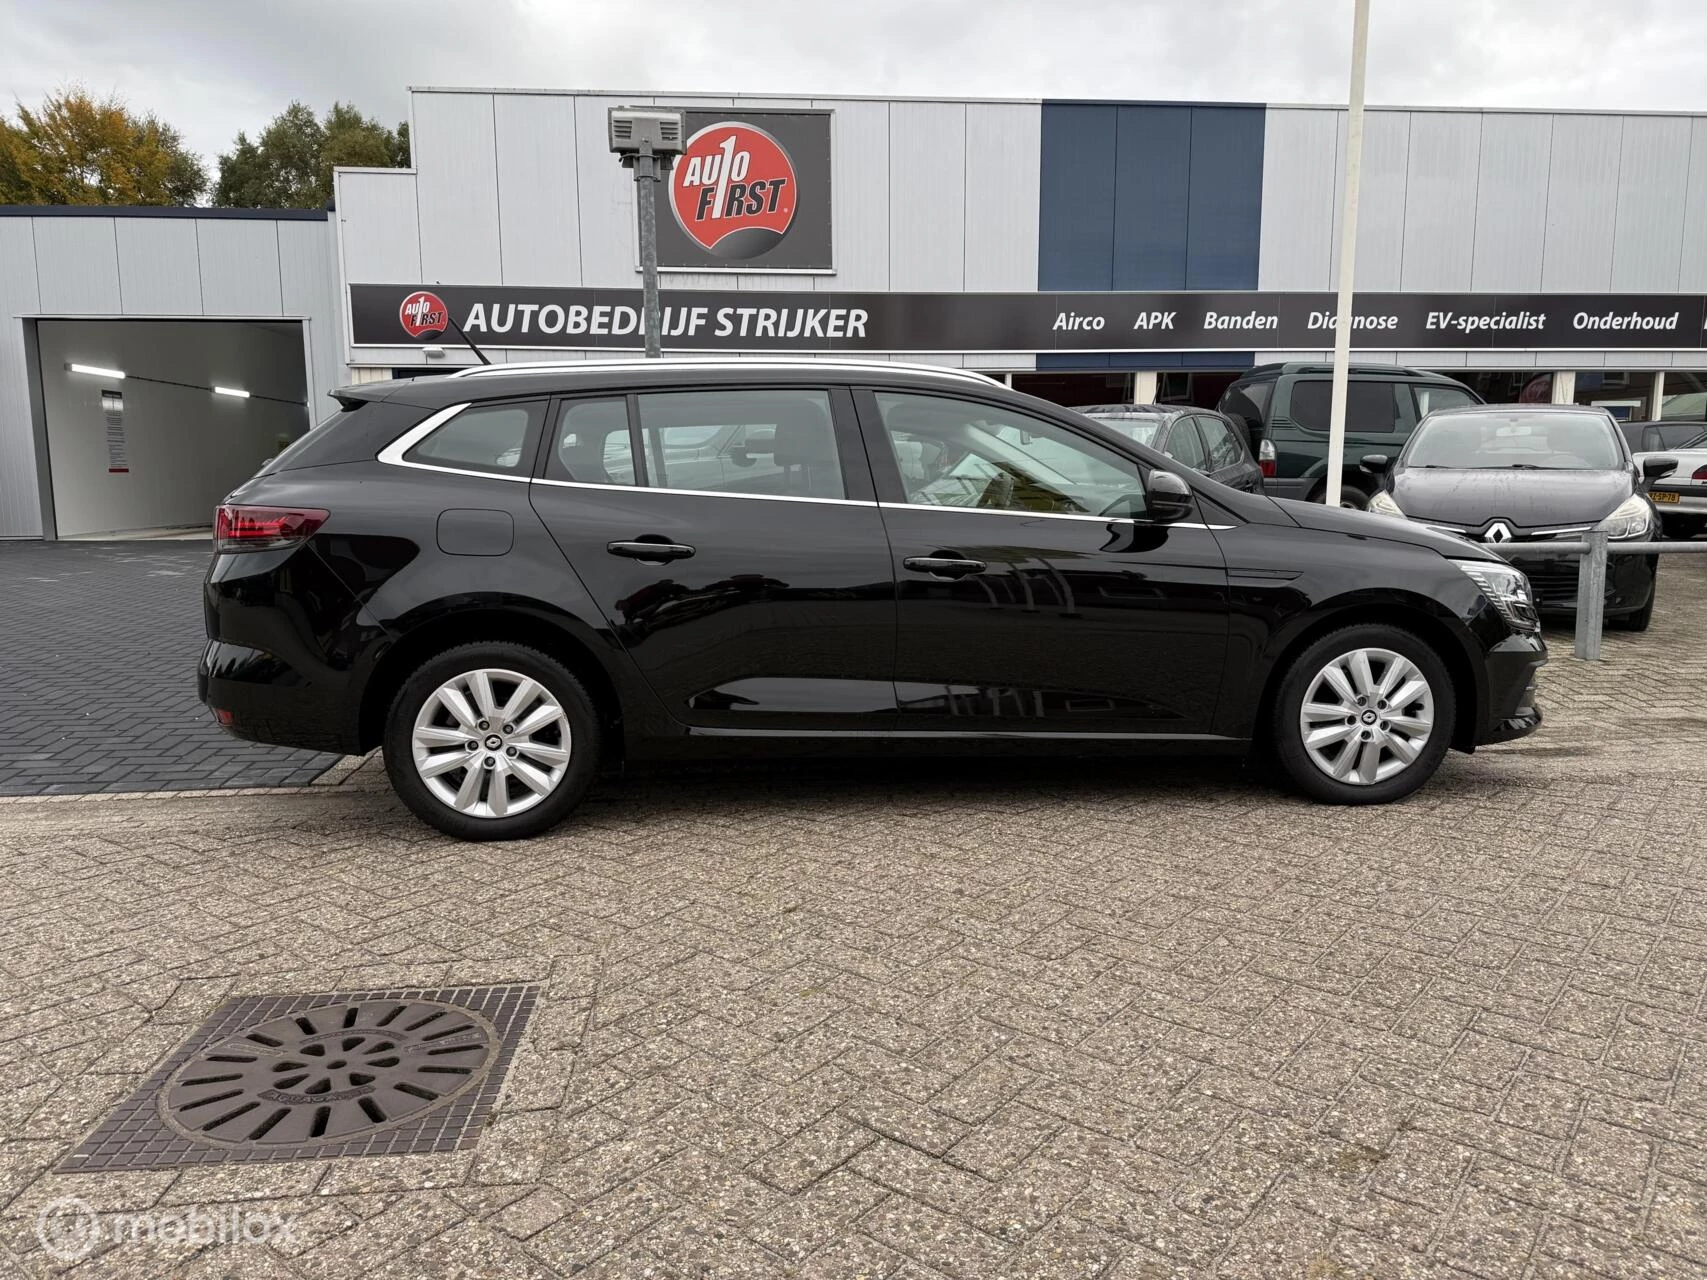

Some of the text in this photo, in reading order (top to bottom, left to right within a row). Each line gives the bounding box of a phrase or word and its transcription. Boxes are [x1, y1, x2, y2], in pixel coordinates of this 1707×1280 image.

[715, 307, 868, 338] STRIJKER
[1053, 311, 1680, 334] Airco APK Banden Dianose EV-specialist Onderhoud
